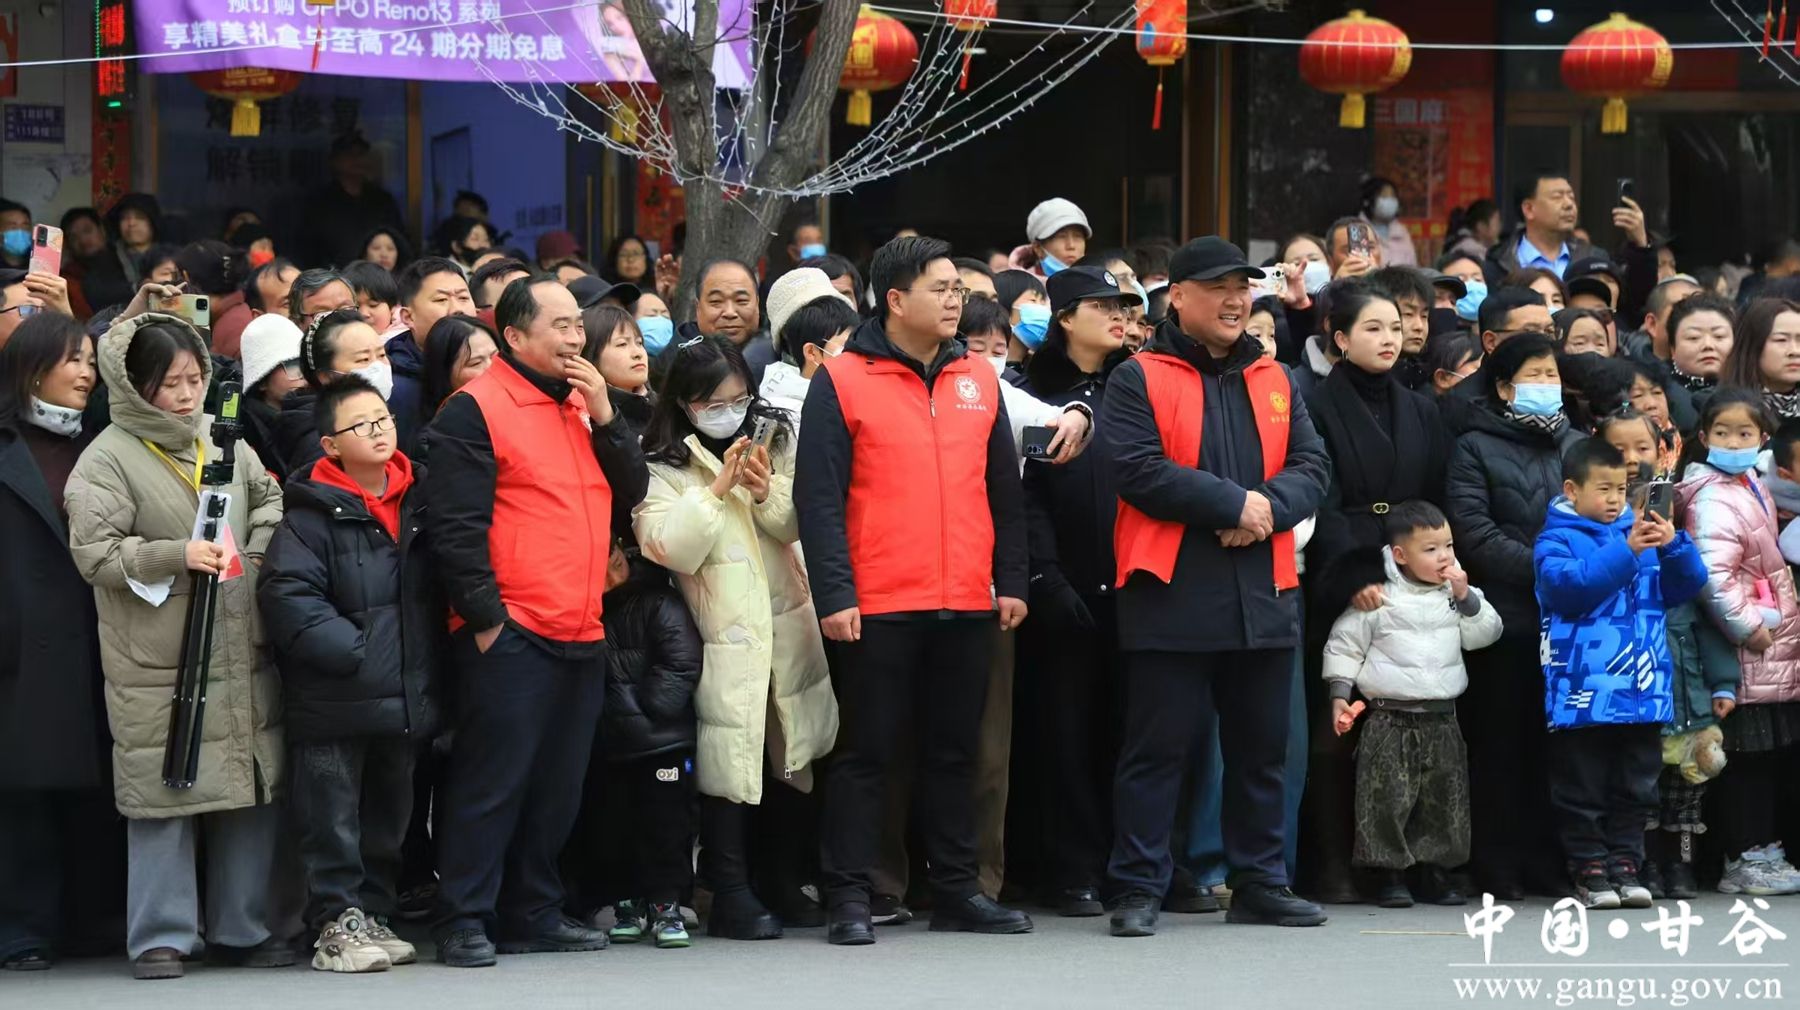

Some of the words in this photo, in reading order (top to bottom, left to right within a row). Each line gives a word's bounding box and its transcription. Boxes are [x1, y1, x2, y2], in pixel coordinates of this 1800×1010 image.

[374, 0, 451, 22] Reno13
[458, 0, 500, 23] 系列
[390, 31, 425, 57] 24
[431, 31, 566, 61] 期分期免息
